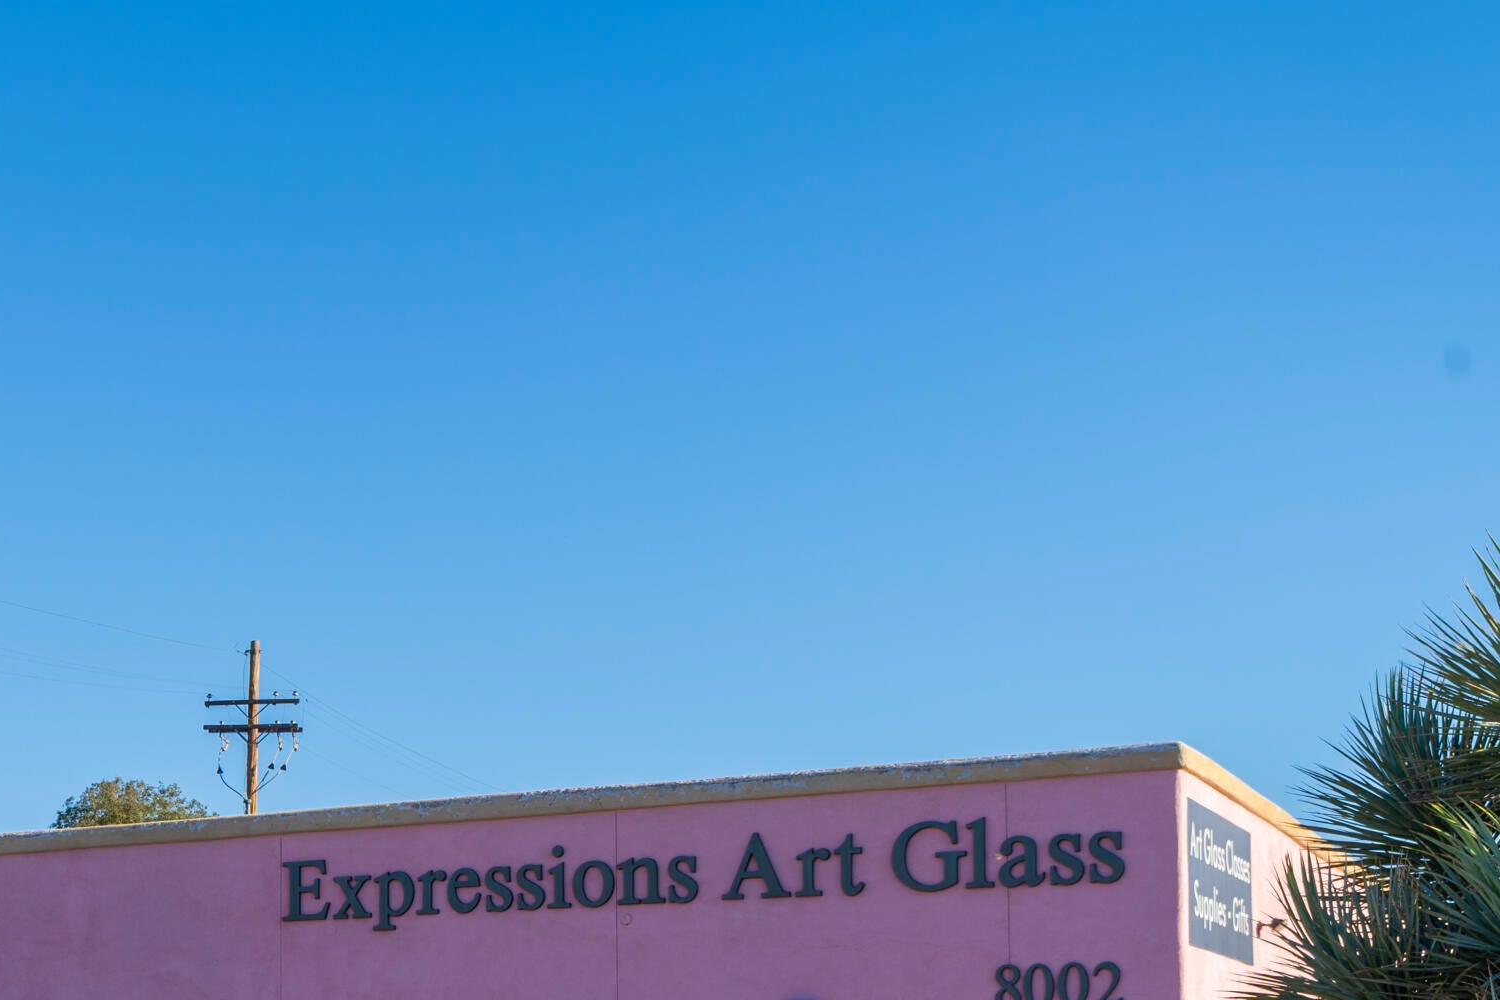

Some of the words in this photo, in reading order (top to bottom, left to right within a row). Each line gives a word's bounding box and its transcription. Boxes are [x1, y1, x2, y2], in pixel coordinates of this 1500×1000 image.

[281, 845, 700, 931] Expressions
[721, 832, 867, 900] Art
[891, 817, 1126, 893] Glass
[1190, 820, 1203, 861] Art
[1203, 827, 1226, 873] Glass
[1226, 839, 1251, 885] Classes
[1194, 879, 1227, 931] Supplies
[1232, 896, 1250, 937] Gifts
